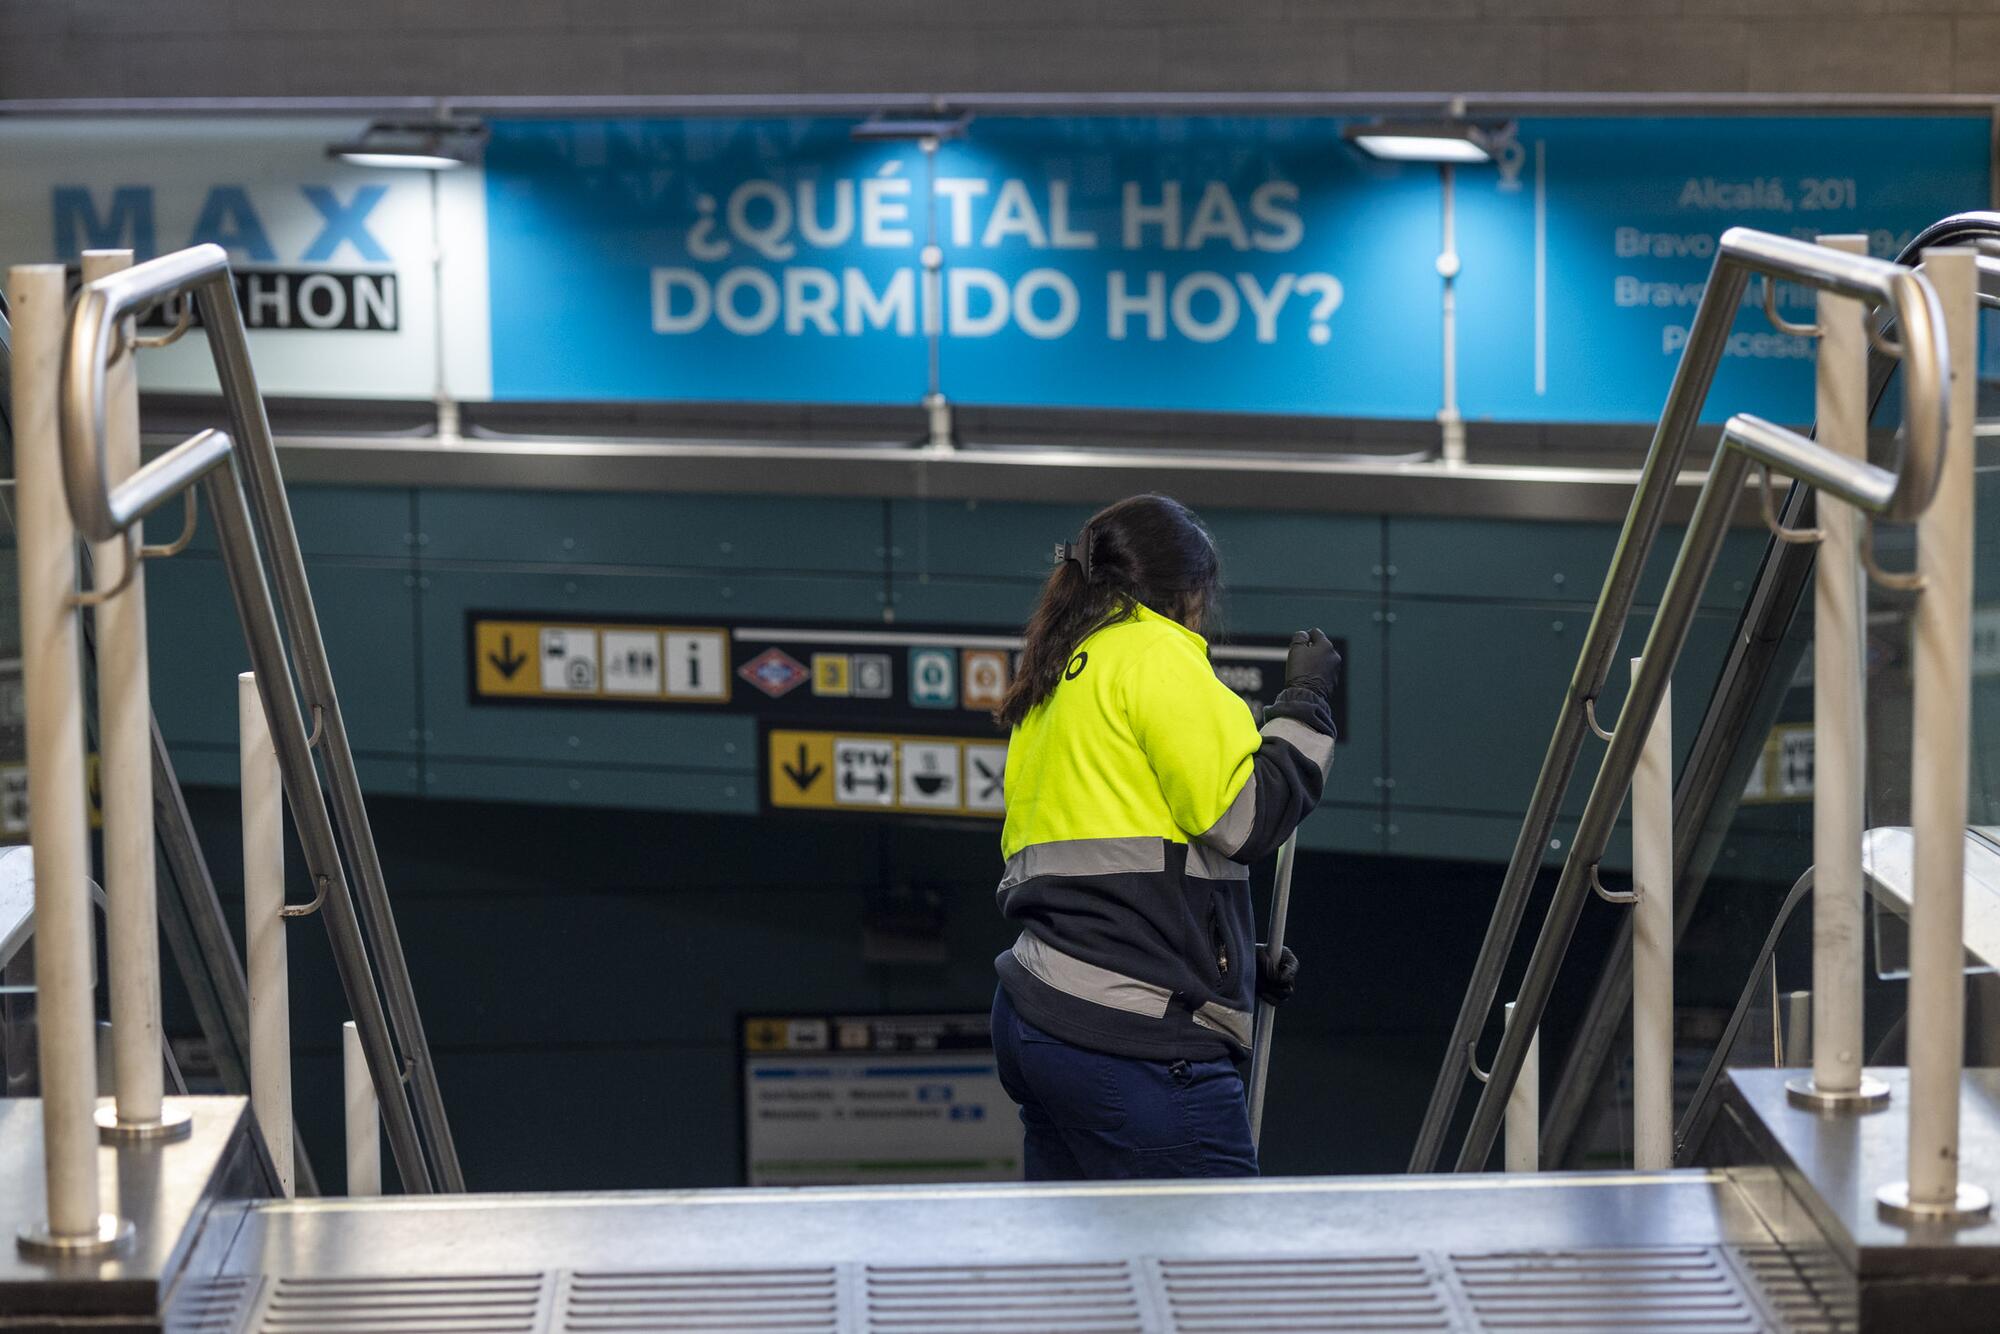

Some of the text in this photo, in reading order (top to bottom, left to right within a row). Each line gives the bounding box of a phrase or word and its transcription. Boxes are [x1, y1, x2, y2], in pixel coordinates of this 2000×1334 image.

[52, 184, 391, 262] MAX
[687, 160, 1305, 261] ¿QUÉ TAL HAS
[1799, 179, 1857, 210] 201
[1615, 226, 1714, 258] Bravo
[651, 267, 1345, 346] DORMIDO HOY?
